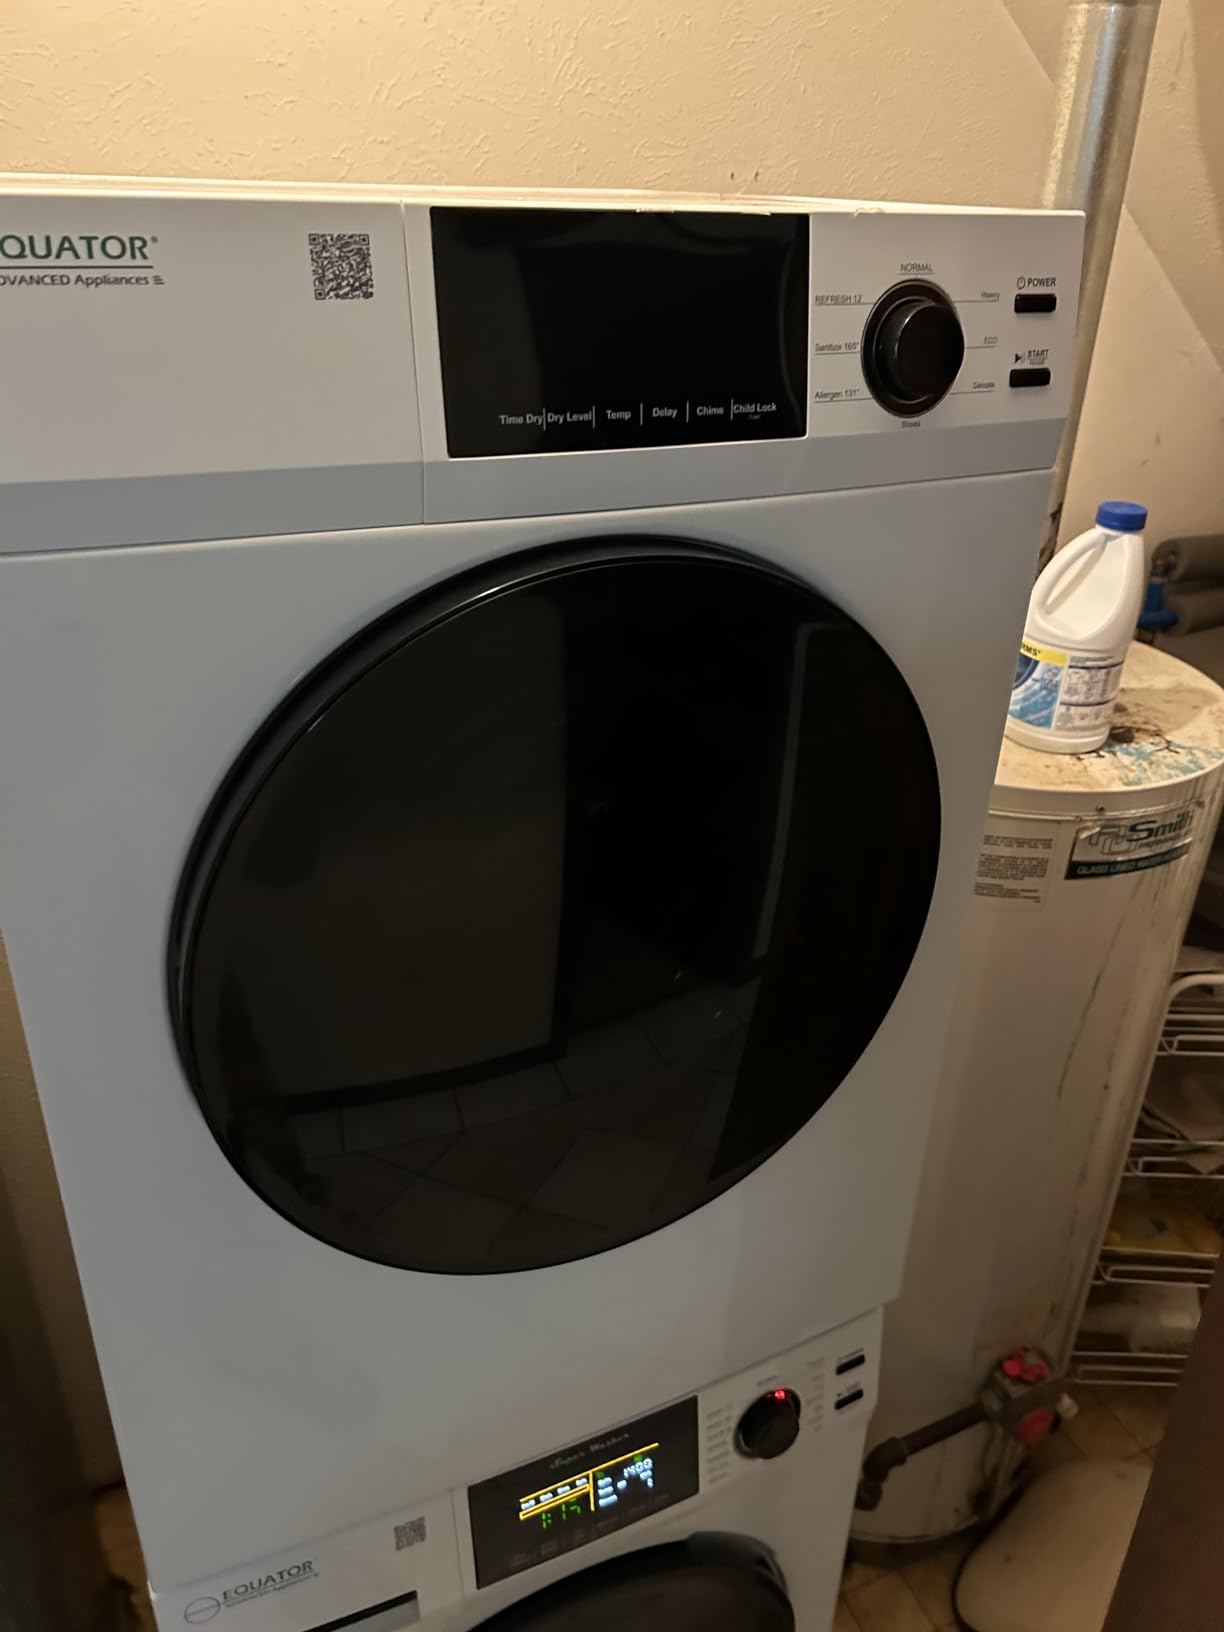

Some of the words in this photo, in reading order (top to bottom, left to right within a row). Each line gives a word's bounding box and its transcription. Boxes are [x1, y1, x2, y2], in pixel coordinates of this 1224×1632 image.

[900, 263, 933, 272] NORMAL
[74, 274, 149, 288] Appliances
[1027, 277, 1057, 287] POWER
[815, 295, 851, 304] REFRESH
[1027, 349, 1049, 358] START
[815, 391, 843, 400] Allergen
[652, 407, 677, 419] Delay
[696, 405, 724, 416] Chime
[733, 403, 755, 414] Child
[756, 402, 777, 412] Lock
[500, 414, 524, 425] Time
[526, 413, 543, 426] Dry
[547, 412, 564, 425] Dry
[566, 410, 592, 422] Level
[606, 409, 631, 421] Temp
[222, 1560, 313, 1600] EQUATOR
